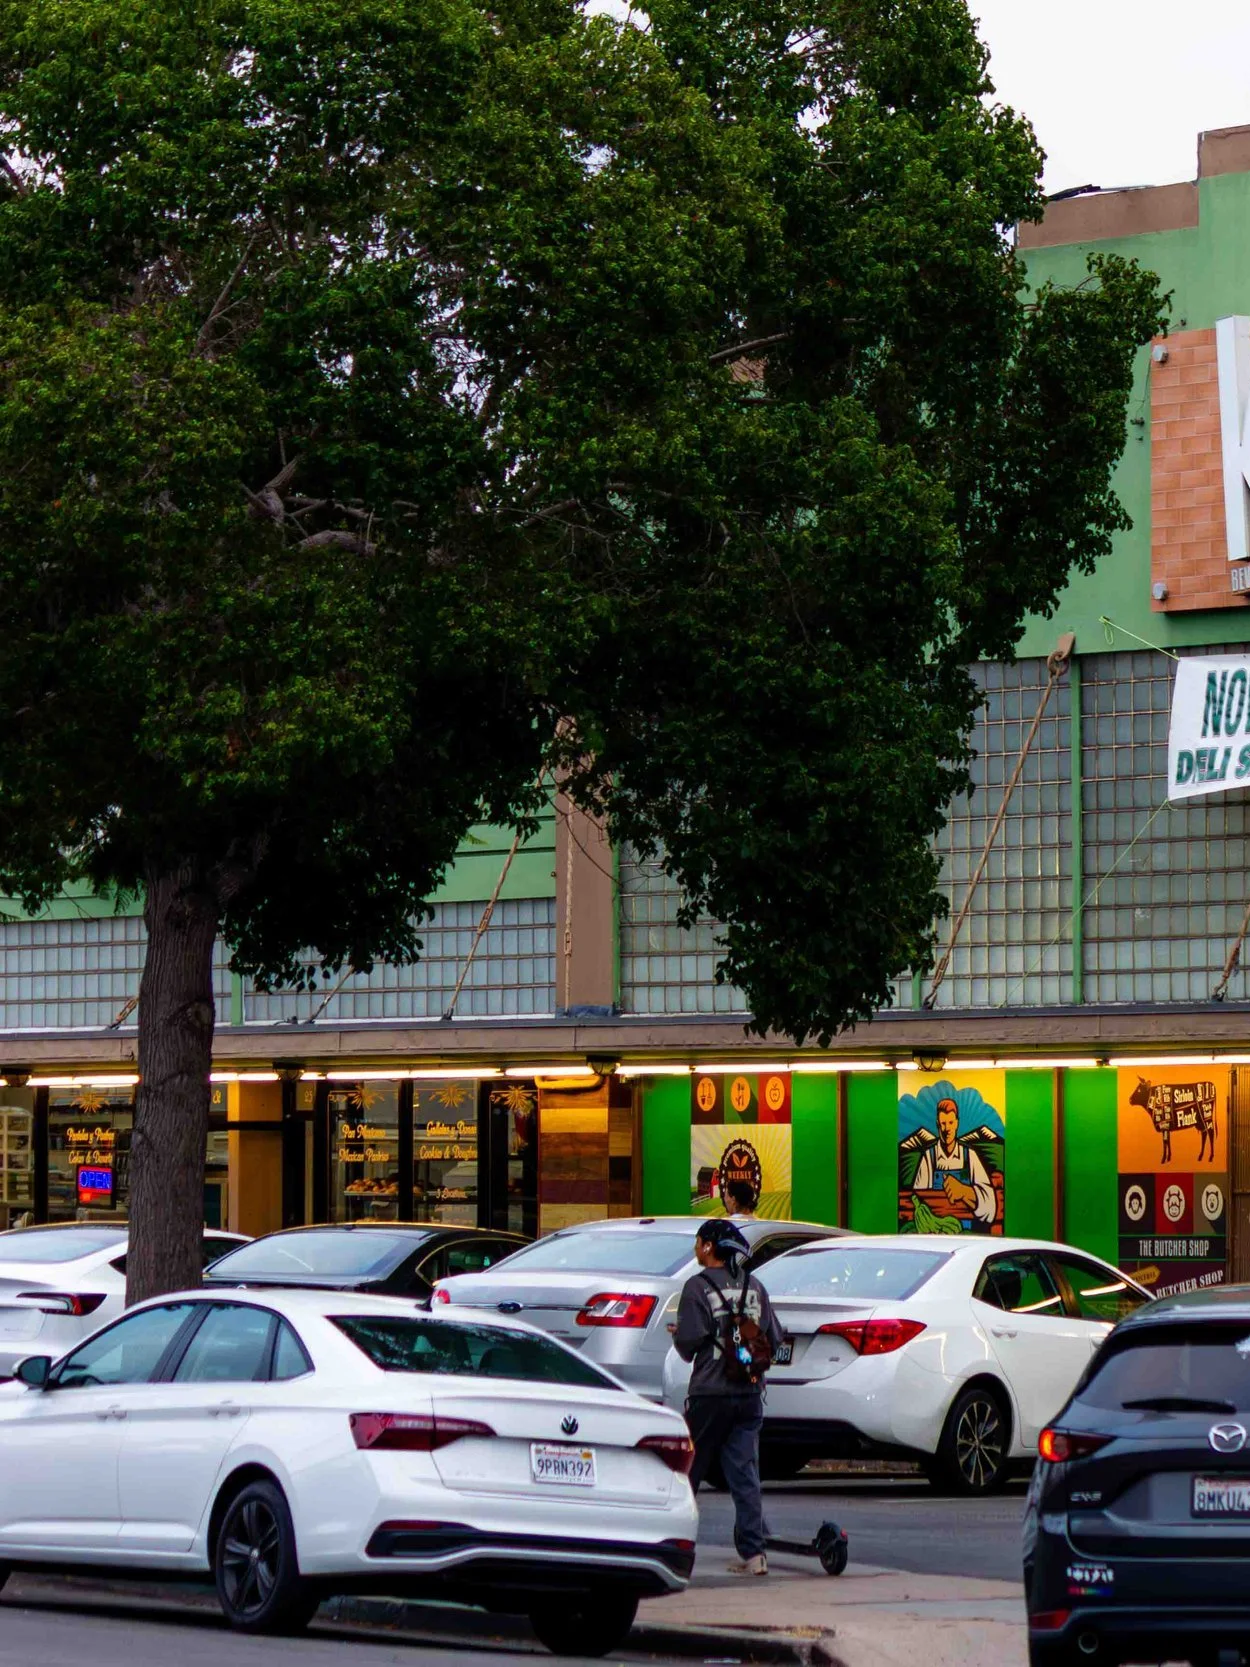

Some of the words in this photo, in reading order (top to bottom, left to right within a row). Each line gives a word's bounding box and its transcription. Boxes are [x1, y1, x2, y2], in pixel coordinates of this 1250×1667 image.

[1175, 745, 1231, 785] DELI
[1173, 1088, 1194, 1104] Sirloin
[1176, 1108, 1197, 1127] Flank
[338, 1148, 364, 1162] Mexican
[80, 1171, 111, 1188] OPEN
[1139, 1239, 1153, 1257] THE
[1154, 1239, 1187, 1257] BUTCHER
[1189, 1239, 1210, 1257] SHOP
[1199, 1269, 1224, 1288] SHOP
